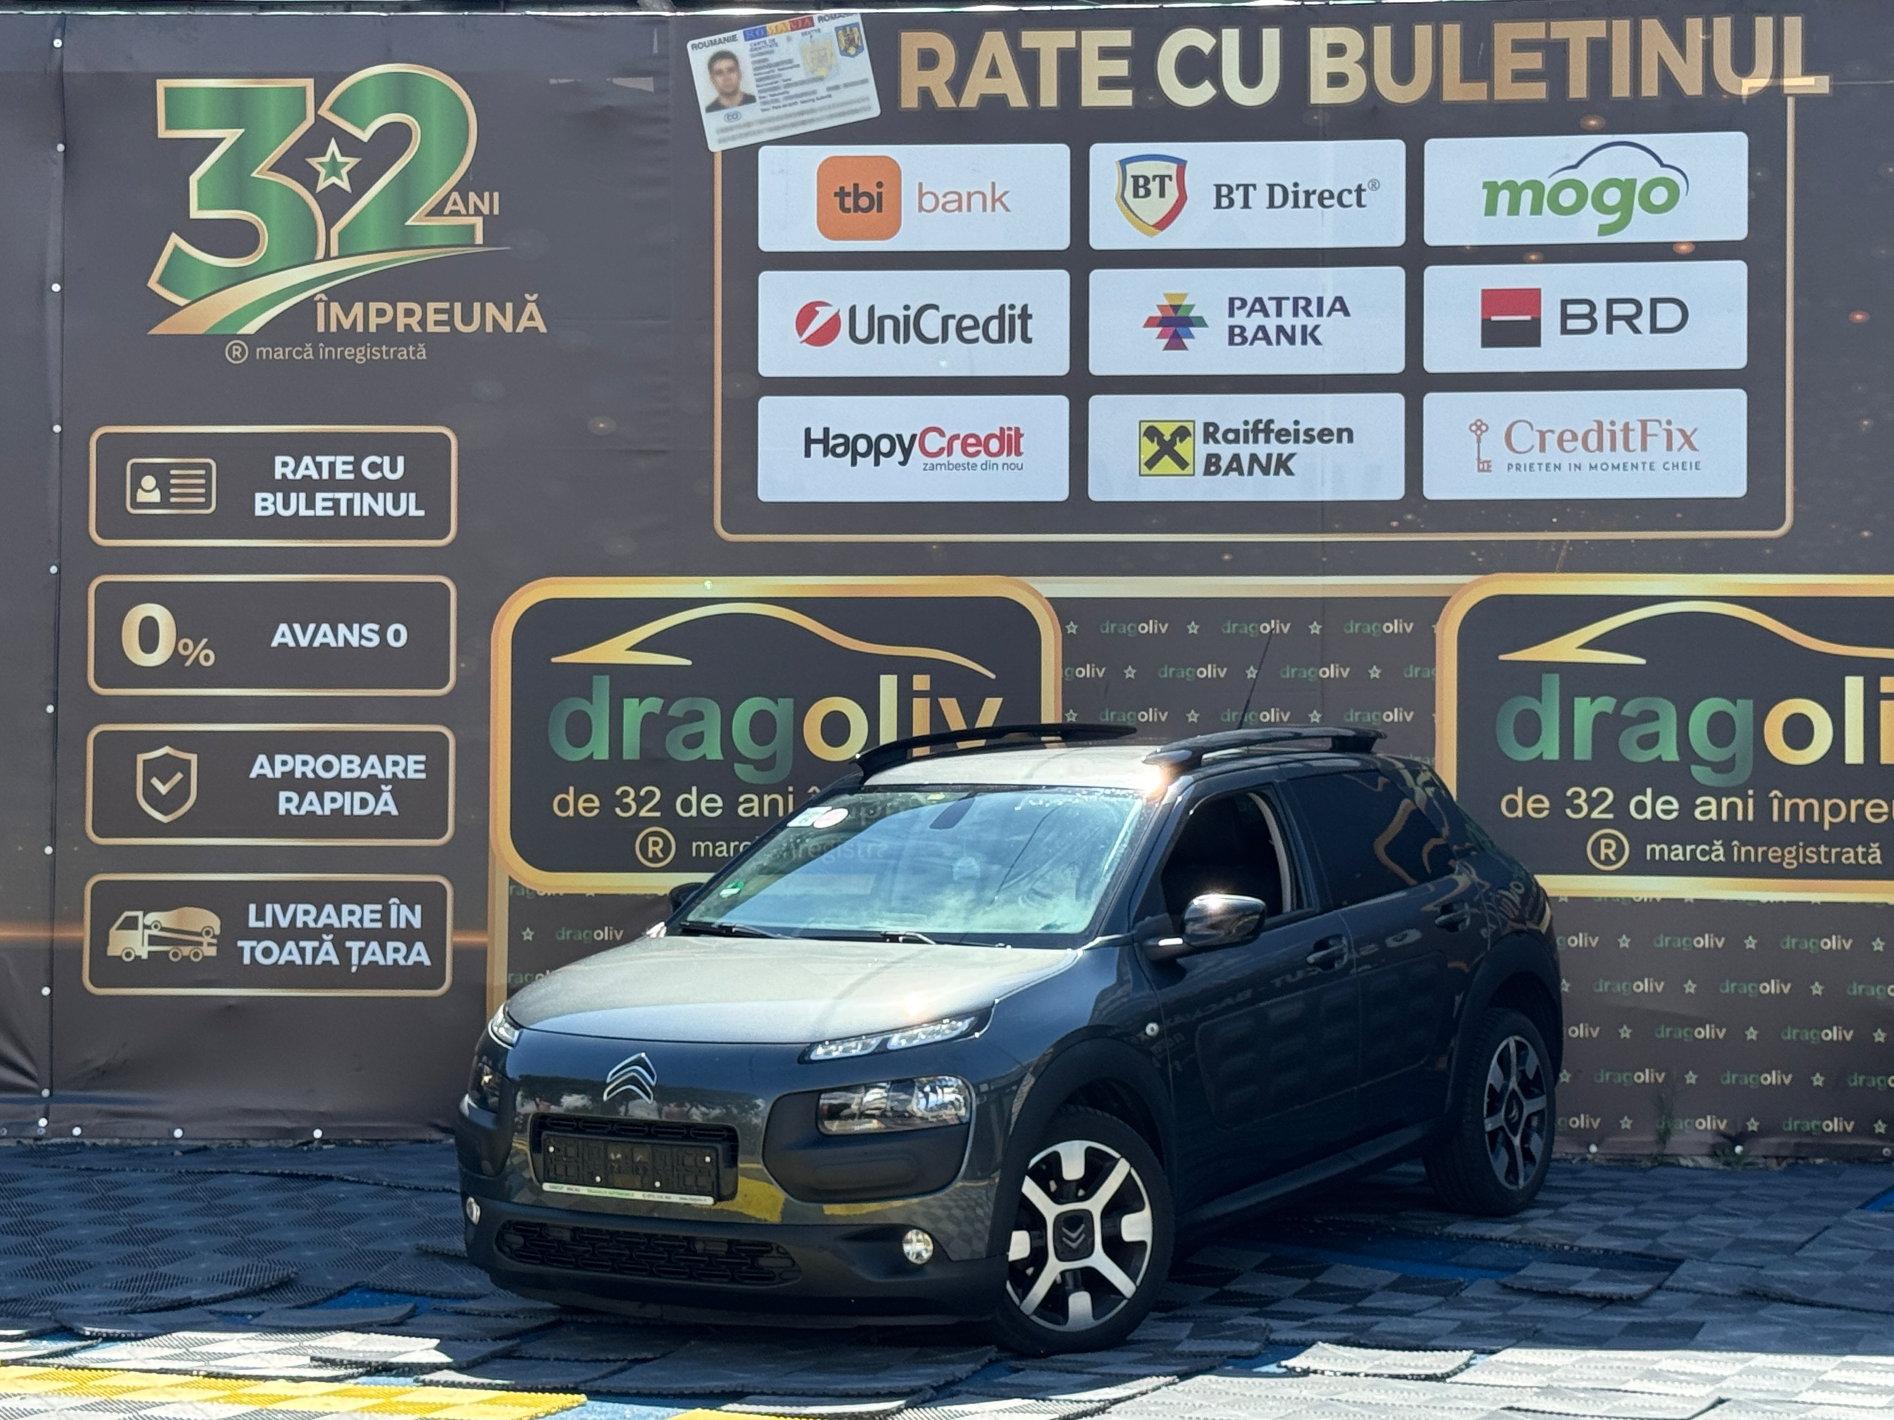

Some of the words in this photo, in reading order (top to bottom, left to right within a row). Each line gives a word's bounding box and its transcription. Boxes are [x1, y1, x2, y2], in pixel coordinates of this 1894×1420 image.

[691, 34, 738, 51] ROUMANIE
[900, 30, 1133, 108] RATE
[1157, 28, 1280, 107] CU
[1309, 16, 1830, 105] BULETINUL
[833, 181, 884, 214] tbi
[917, 181, 1011, 214] bank
[1130, 174, 1173, 199] BT
[1213, 183, 1257, 210] BT
[443, 192, 500, 215] ANI
[1482, 176, 1681, 237] mogo
[314, 293, 547, 334] ÎMPREUNĂ
[1227, 296, 1352, 319] PATRIA
[1560, 297, 1690, 336] BRD
[849, 303, 1033, 345] UniCredit
[1227, 324, 1323, 347] BANK
[256, 343, 314, 361] marcă
[319, 343, 427, 365] înregistrată
[1202, 419, 1354, 445] Raiffeisen
[1504, 418, 1700, 454] CreditFix
[804, 426, 1025, 467] HappyCredit
[274, 455, 355, 480] RATE
[361, 455, 405, 480] CU
[922, 460, 978, 472] zambeste
[980, 460, 999, 471] din
[1002, 462, 1024, 471] nou
[1202, 452, 1298, 477] BANK
[1507, 462, 1562, 473] PRIETEN
[1568, 462, 1582, 472] IN
[1589, 461, 1656, 472] MOMENTE
[1662, 460, 1702, 472] CHEIE
[254, 492, 425, 517] BULETINUL
[270, 623, 380, 648] AVANS
[387, 623, 409, 648] 0
[1100, 619, 1169, 637] dragoliv
[1221, 619, 1291, 637] dragoliv
[1343, 618, 1415, 637] dragoliv
[1063, 664, 1107, 681] goliv
[1158, 664, 1228, 682] dragoliv
[1280, 664, 1351, 682] dragoliv
[1099, 707, 1169, 725] dragoliv
[1343, 707, 1415, 725] dragoliv
[548, 675, 1004, 784] dragoliv
[1495, 673, 1894, 788] dragoli
[249, 754, 427, 779] APROBARE
[278, 784, 399, 816] RAPIDĂ
[553, 787, 600, 818] de
[614, 786, 662, 818] 32
[675, 786, 724, 818] de
[738, 786, 794, 818] ani
[1500, 786, 1550, 819] de
[1564, 787, 1615, 820] 32
[1629, 787, 1679, 821] de
[1694, 789, 1754, 821] ani
[1767, 789, 1894, 832] împre
[692, 838, 755, 858] marc
[1646, 838, 1725, 862] marcă
[1732, 841, 1883, 870] înregistrată
[248, 903, 382, 929] LIVRARE
[389, 897, 422, 929] ÎN
[555, 926, 624, 944] dragoliv
[1556, 932, 1600, 949] goliv
[1653, 933, 1726, 950] dragoliv
[1780, 934, 1854, 953] dragoliv
[237, 934, 339, 966] TOATĂ
[345, 940, 431, 973] ȚARA
[1593, 978, 1666, 996] dragoliv
[1719, 979, 1793, 997] dragoliv
[1654, 1023, 1727, 1041] dragoliv
[1781, 1025, 1855, 1044] dragoliv
[1594, 1067, 1666, 1085] dragoliv
[1720, 1069, 1793, 1087] dragoliv
[1557, 1113, 1601, 1130] goliv
[1782, 1116, 1855, 1135] dragoliv
